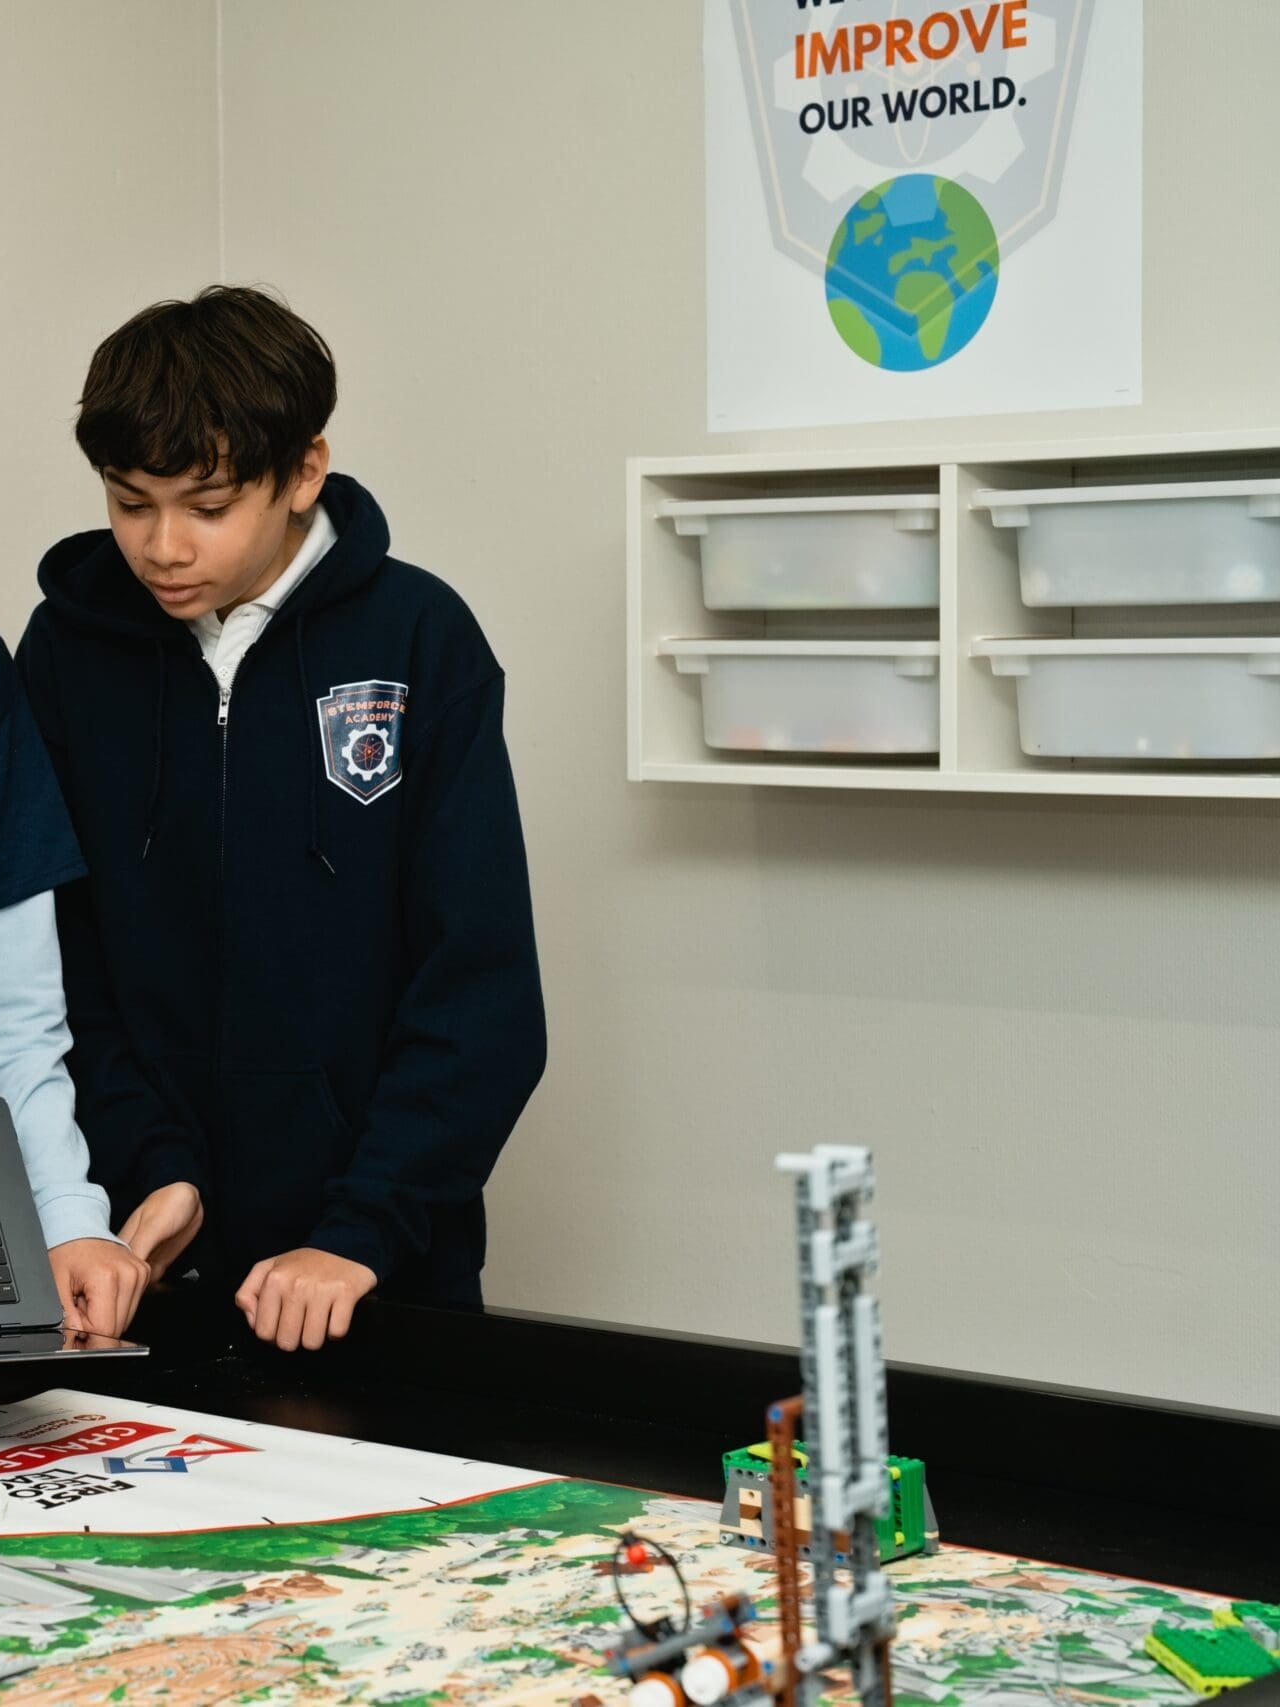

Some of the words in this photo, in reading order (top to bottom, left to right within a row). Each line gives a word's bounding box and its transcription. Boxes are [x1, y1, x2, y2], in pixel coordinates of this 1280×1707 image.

[794, 0, 1028, 80] IMPROVE
[799, 97, 873, 134] OUR
[882, 76, 1027, 124] WORLD.
[327, 701, 406, 716] STEMFORCE
[345, 713, 395, 724] ACADEMY
[8, 1474, 109, 1499] LEGO
[35, 1480, 136, 1509] FIRST
